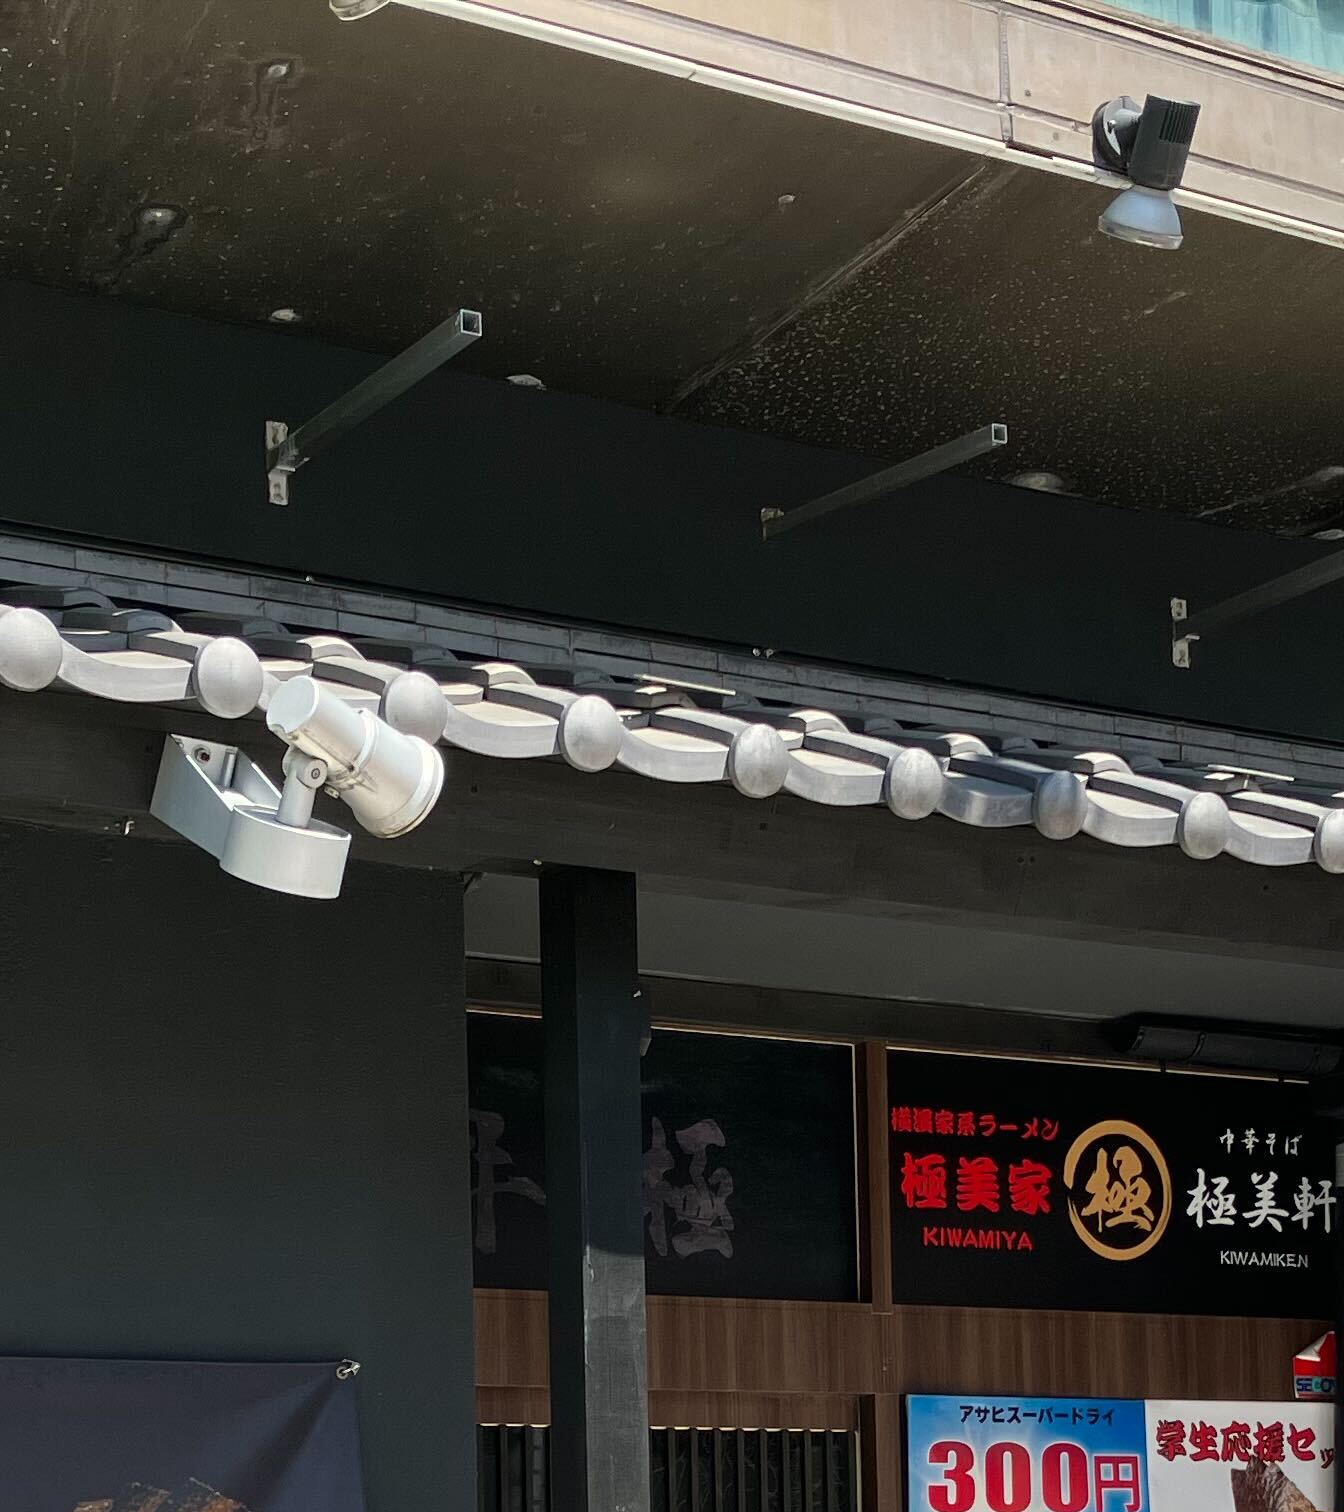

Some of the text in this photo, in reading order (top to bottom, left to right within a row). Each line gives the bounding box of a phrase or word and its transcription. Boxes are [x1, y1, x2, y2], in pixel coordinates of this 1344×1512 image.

[1218, 1127, 1303, 1155] 中華そば
[901, 1152, 1053, 1215] 極美家
[1186, 1167, 1338, 1234] 極美軒
[923, 1226, 1034, 1251] KIWAMIYA
[1219, 1249, 1309, 1268] KIWAMIKEN
[1296, 1378, 1336, 1392] SECO
[959, 1405, 1115, 1425] アサヒスーパードライ
